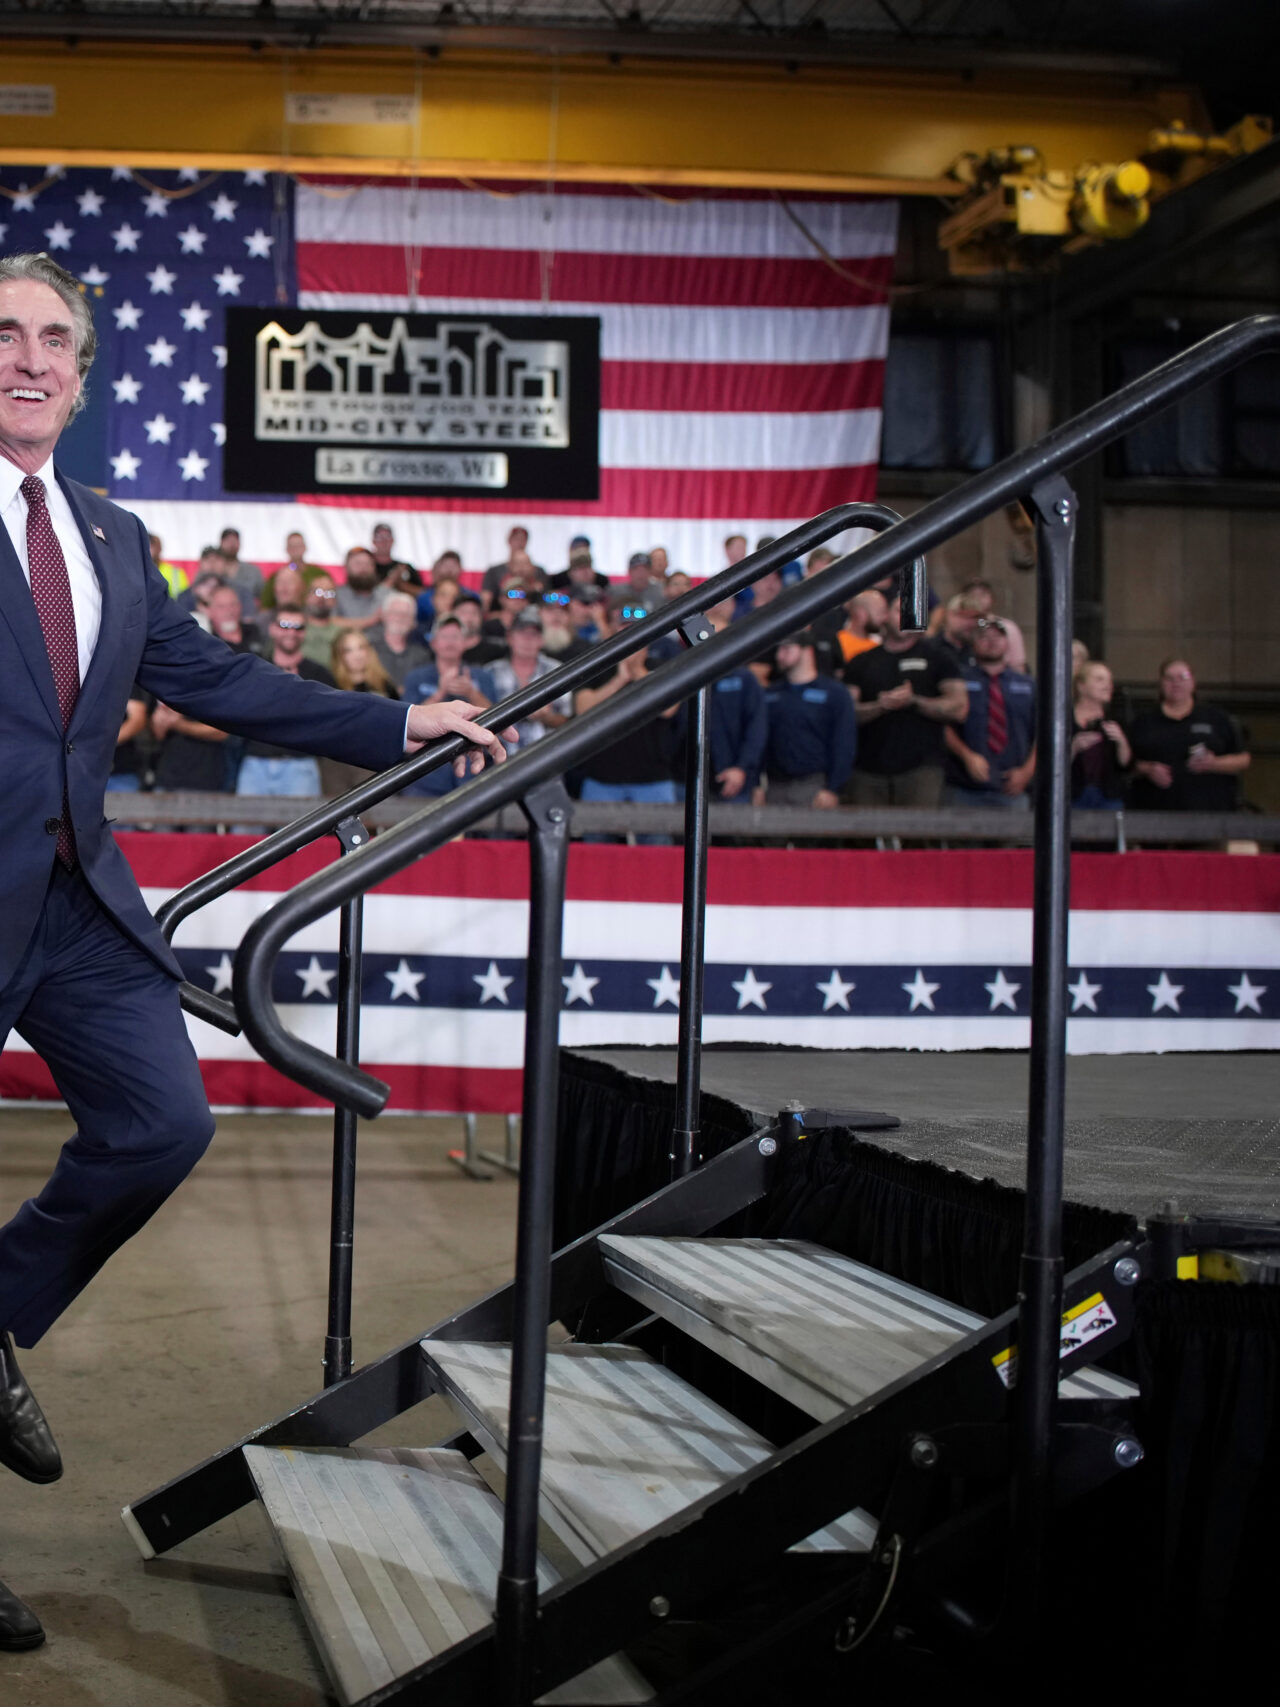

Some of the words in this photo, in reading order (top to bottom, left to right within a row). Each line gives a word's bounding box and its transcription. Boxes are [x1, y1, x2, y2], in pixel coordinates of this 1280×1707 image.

[271, 398, 315, 413] THE
[487, 403, 554, 416] TEAM
[264, 417, 434, 437] MID-CITY
[447, 420, 559, 438] STEEL
[326, 455, 355, 475] La
[362, 456, 457, 481] Crosse,
[461, 458, 496, 478] WI
